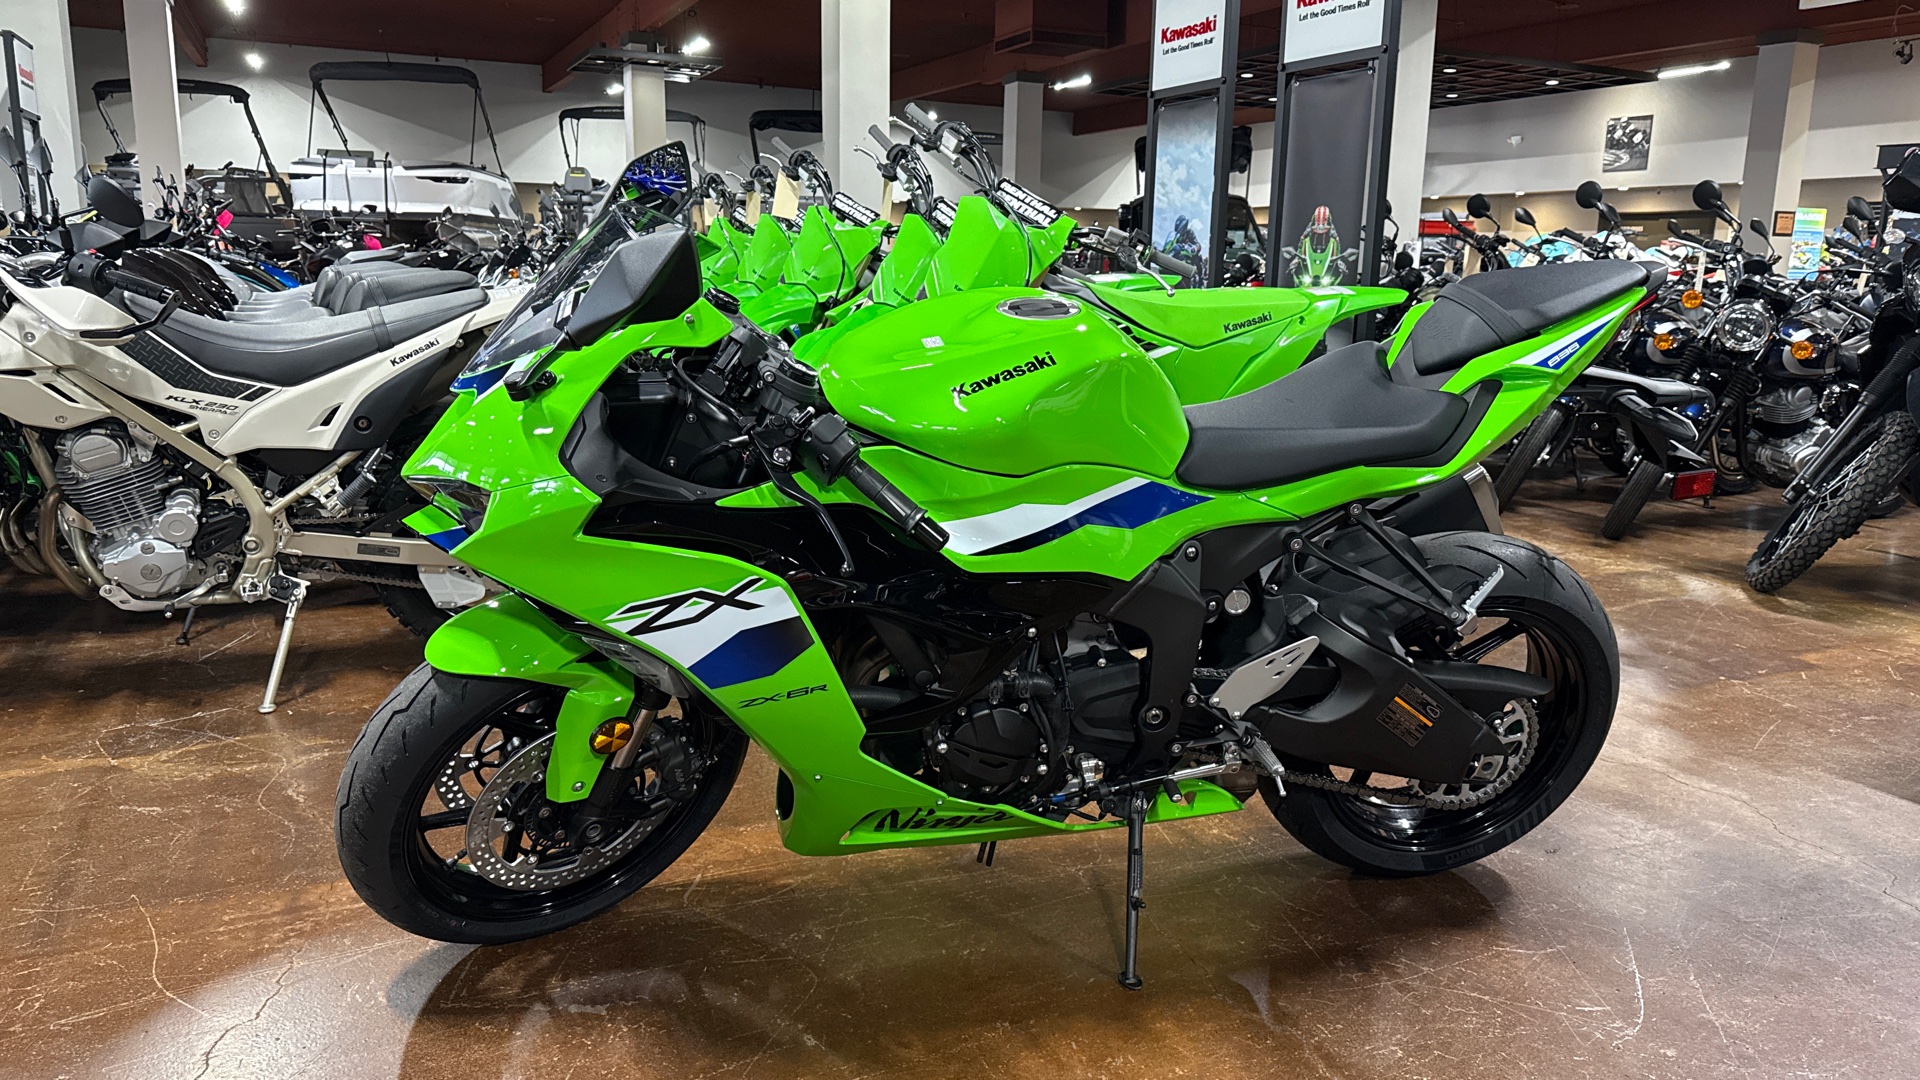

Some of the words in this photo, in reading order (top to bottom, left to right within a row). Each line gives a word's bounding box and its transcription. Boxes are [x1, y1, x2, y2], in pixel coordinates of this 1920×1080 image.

[1320, 6, 1337, 17] Good
[1338, 3, 1356, 13] Times
[1161, 14, 1217, 44] Kawasaki
[998, 181, 1059, 220] RENTHAL
[1223, 311, 1273, 334] Kawasaki
[390, 337, 441, 367] Kawasaki
[951, 351, 1057, 399] Kawasaki
[165, 394, 204, 406] KLX
[204, 401, 239, 411] 230
[616, 576, 766, 637] ZX
[738, 684, 829, 709] ZX-6R
[873, 807, 1013, 833] Ninja
